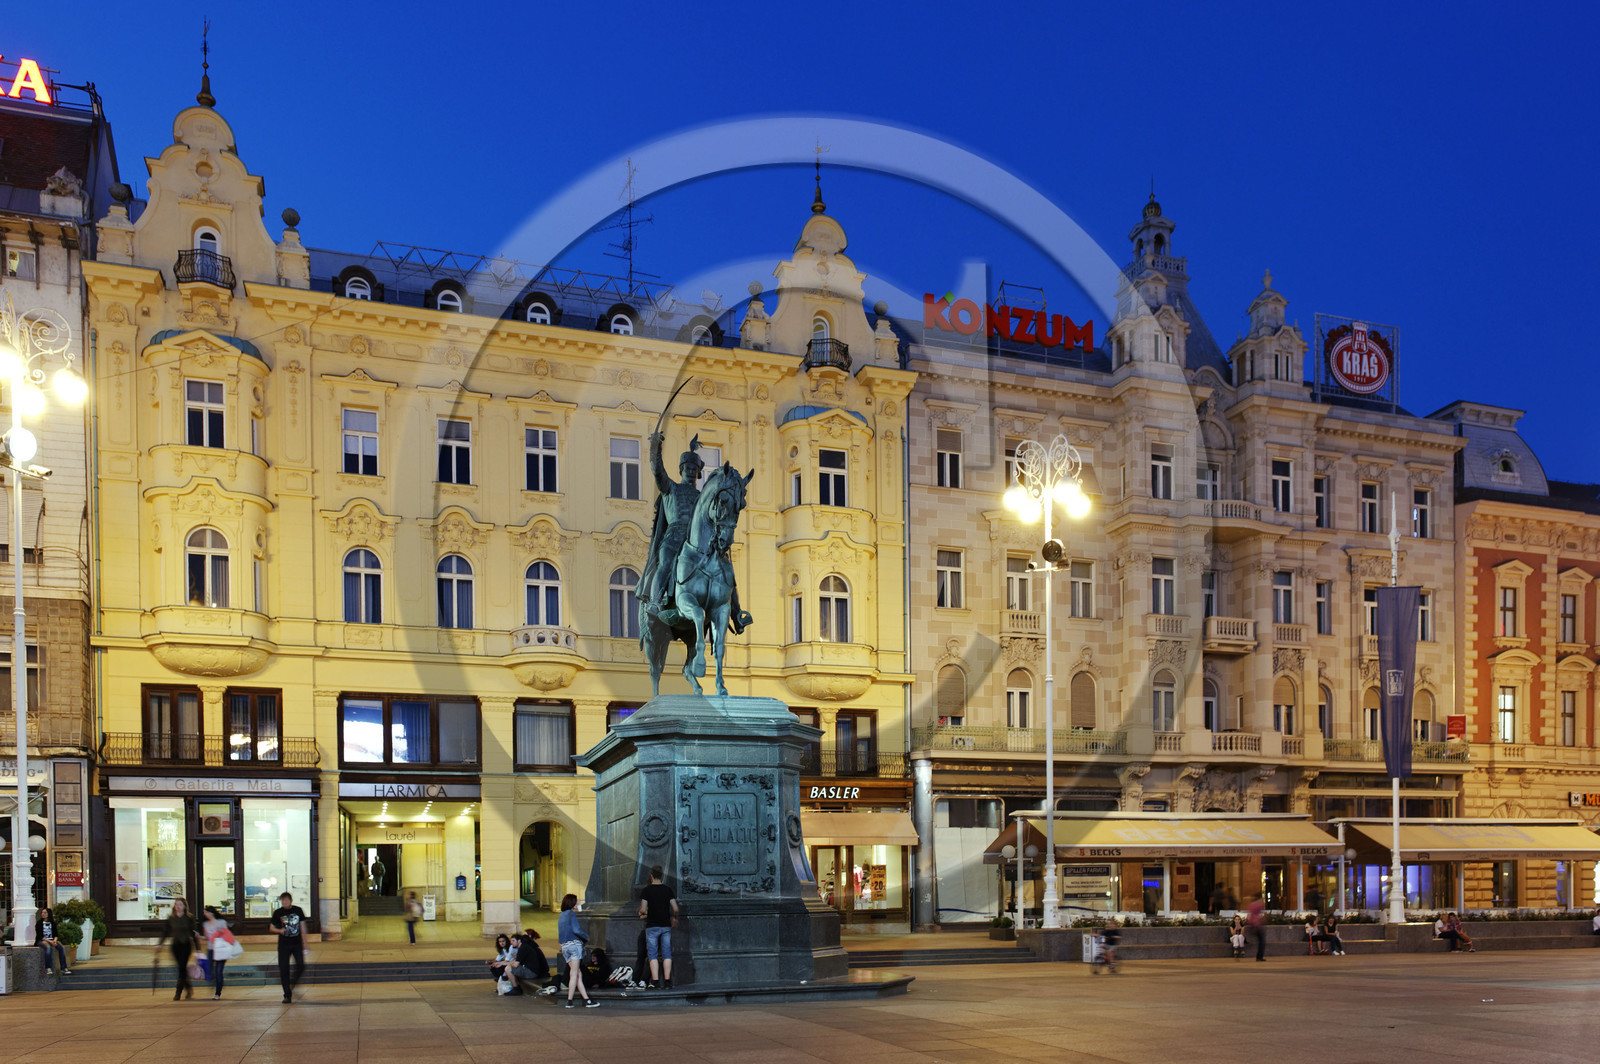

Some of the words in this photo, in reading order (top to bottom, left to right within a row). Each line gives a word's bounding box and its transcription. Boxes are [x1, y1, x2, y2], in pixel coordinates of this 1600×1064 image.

[0, 54, 52, 105] A
[923, 291, 1094, 354] KONZUM
[174, 778, 235, 792] Galerija
[247, 779, 283, 791] Mala
[374, 784, 448, 798] HARMICA
[809, 786, 860, 799] BASLER
[712, 803, 745, 820] BAN
[1111, 825, 1266, 842] BECK'S
[1090, 848, 1122, 856] BECK'S
[1300, 847, 1328, 855] BECK'S
